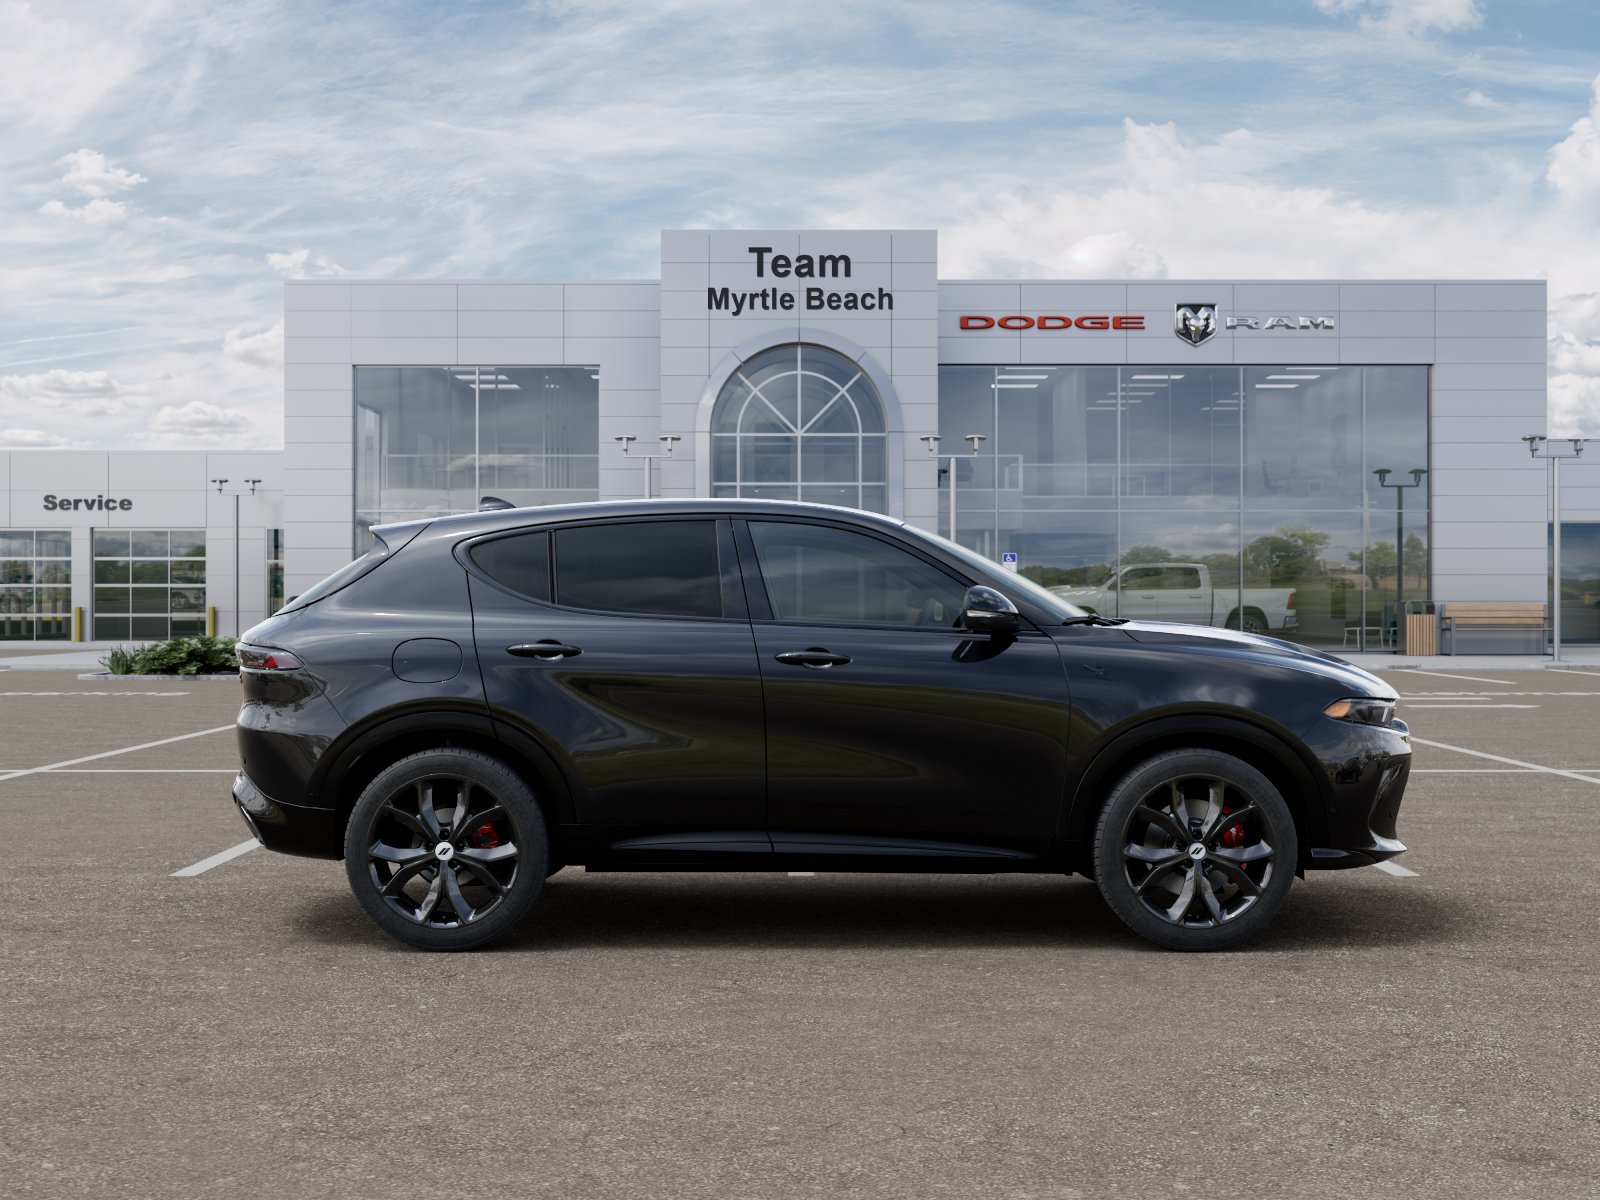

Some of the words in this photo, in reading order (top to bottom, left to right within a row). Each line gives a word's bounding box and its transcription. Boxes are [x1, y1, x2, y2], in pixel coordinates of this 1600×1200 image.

[748, 246, 852, 278] Team
[707, 287, 795, 316] Myrtle
[806, 287, 894, 311] Beach
[959, 315, 1146, 331] DODGE
[1225, 315, 1335, 330] RAM
[43, 494, 133, 511] Service
